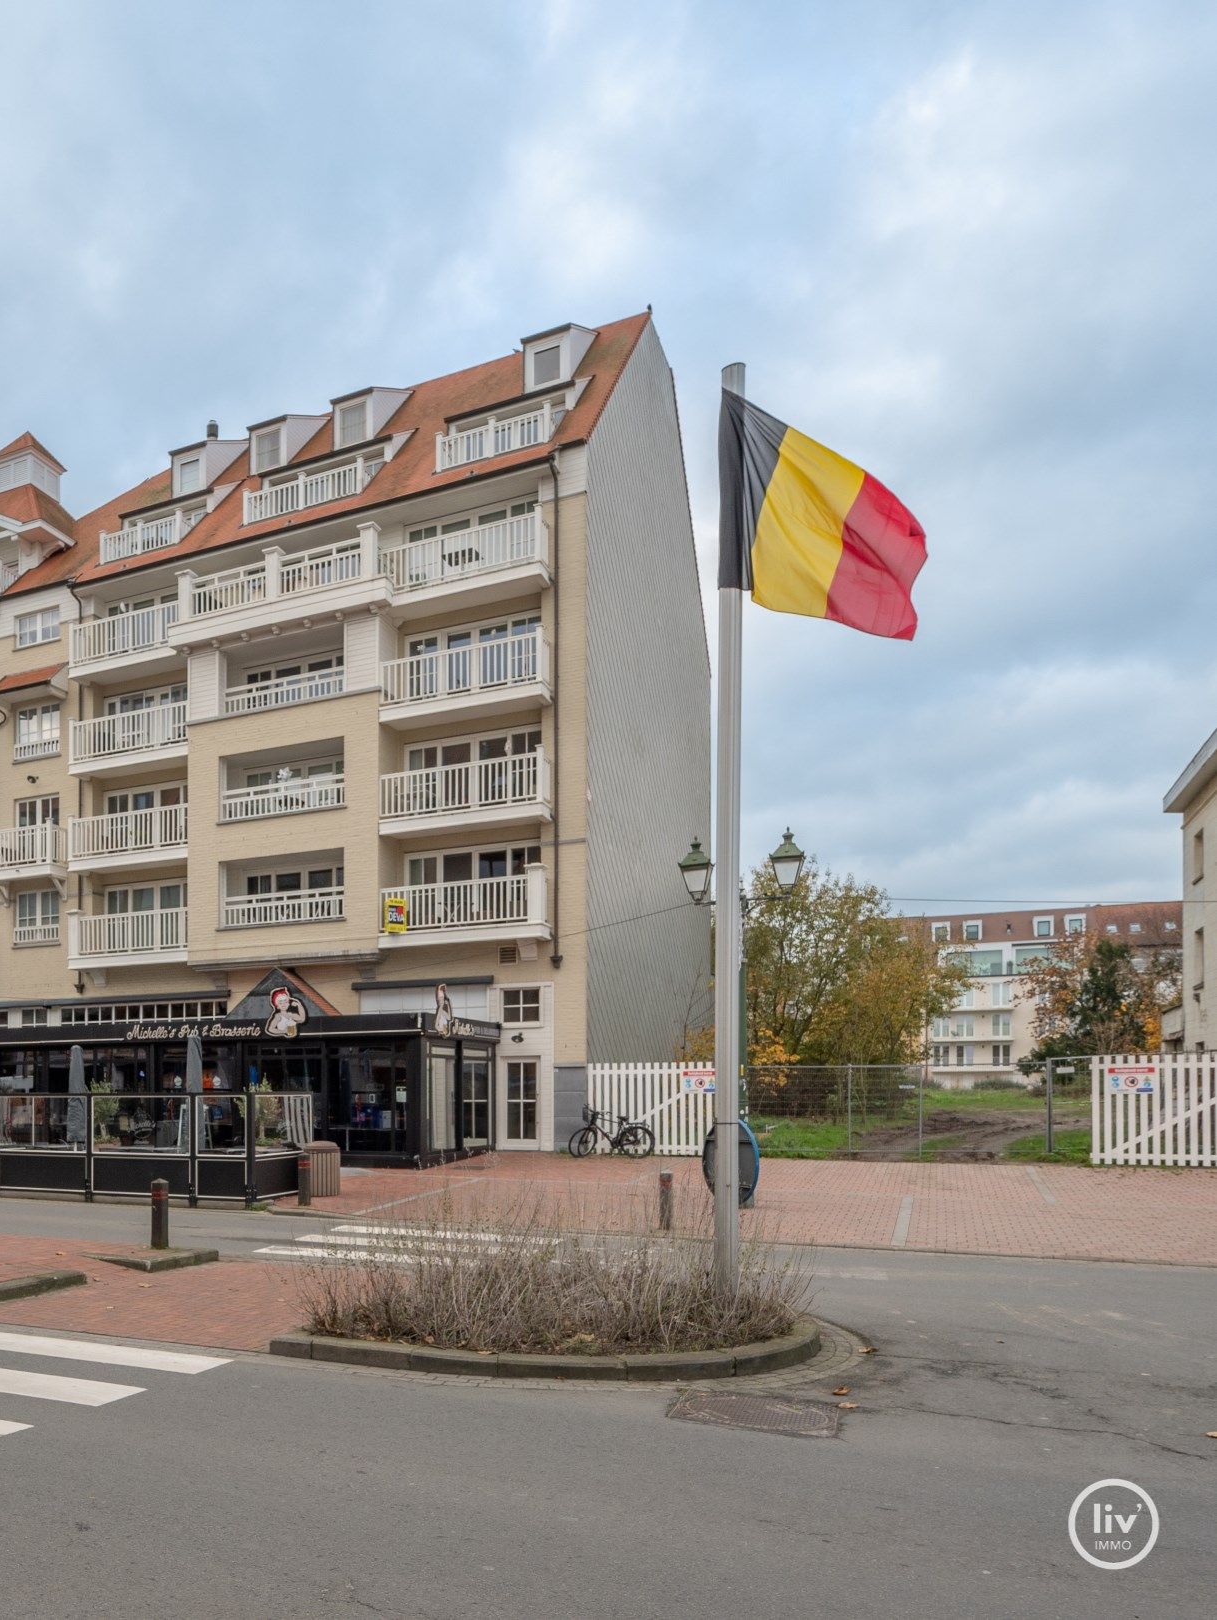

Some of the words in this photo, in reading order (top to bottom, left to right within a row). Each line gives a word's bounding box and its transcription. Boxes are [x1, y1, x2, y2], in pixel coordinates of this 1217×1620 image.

[126, 1024, 176, 1040] Michelle's
[177, 1024, 199, 1038] Pub
[209, 1022, 261, 1037] Brasserie
